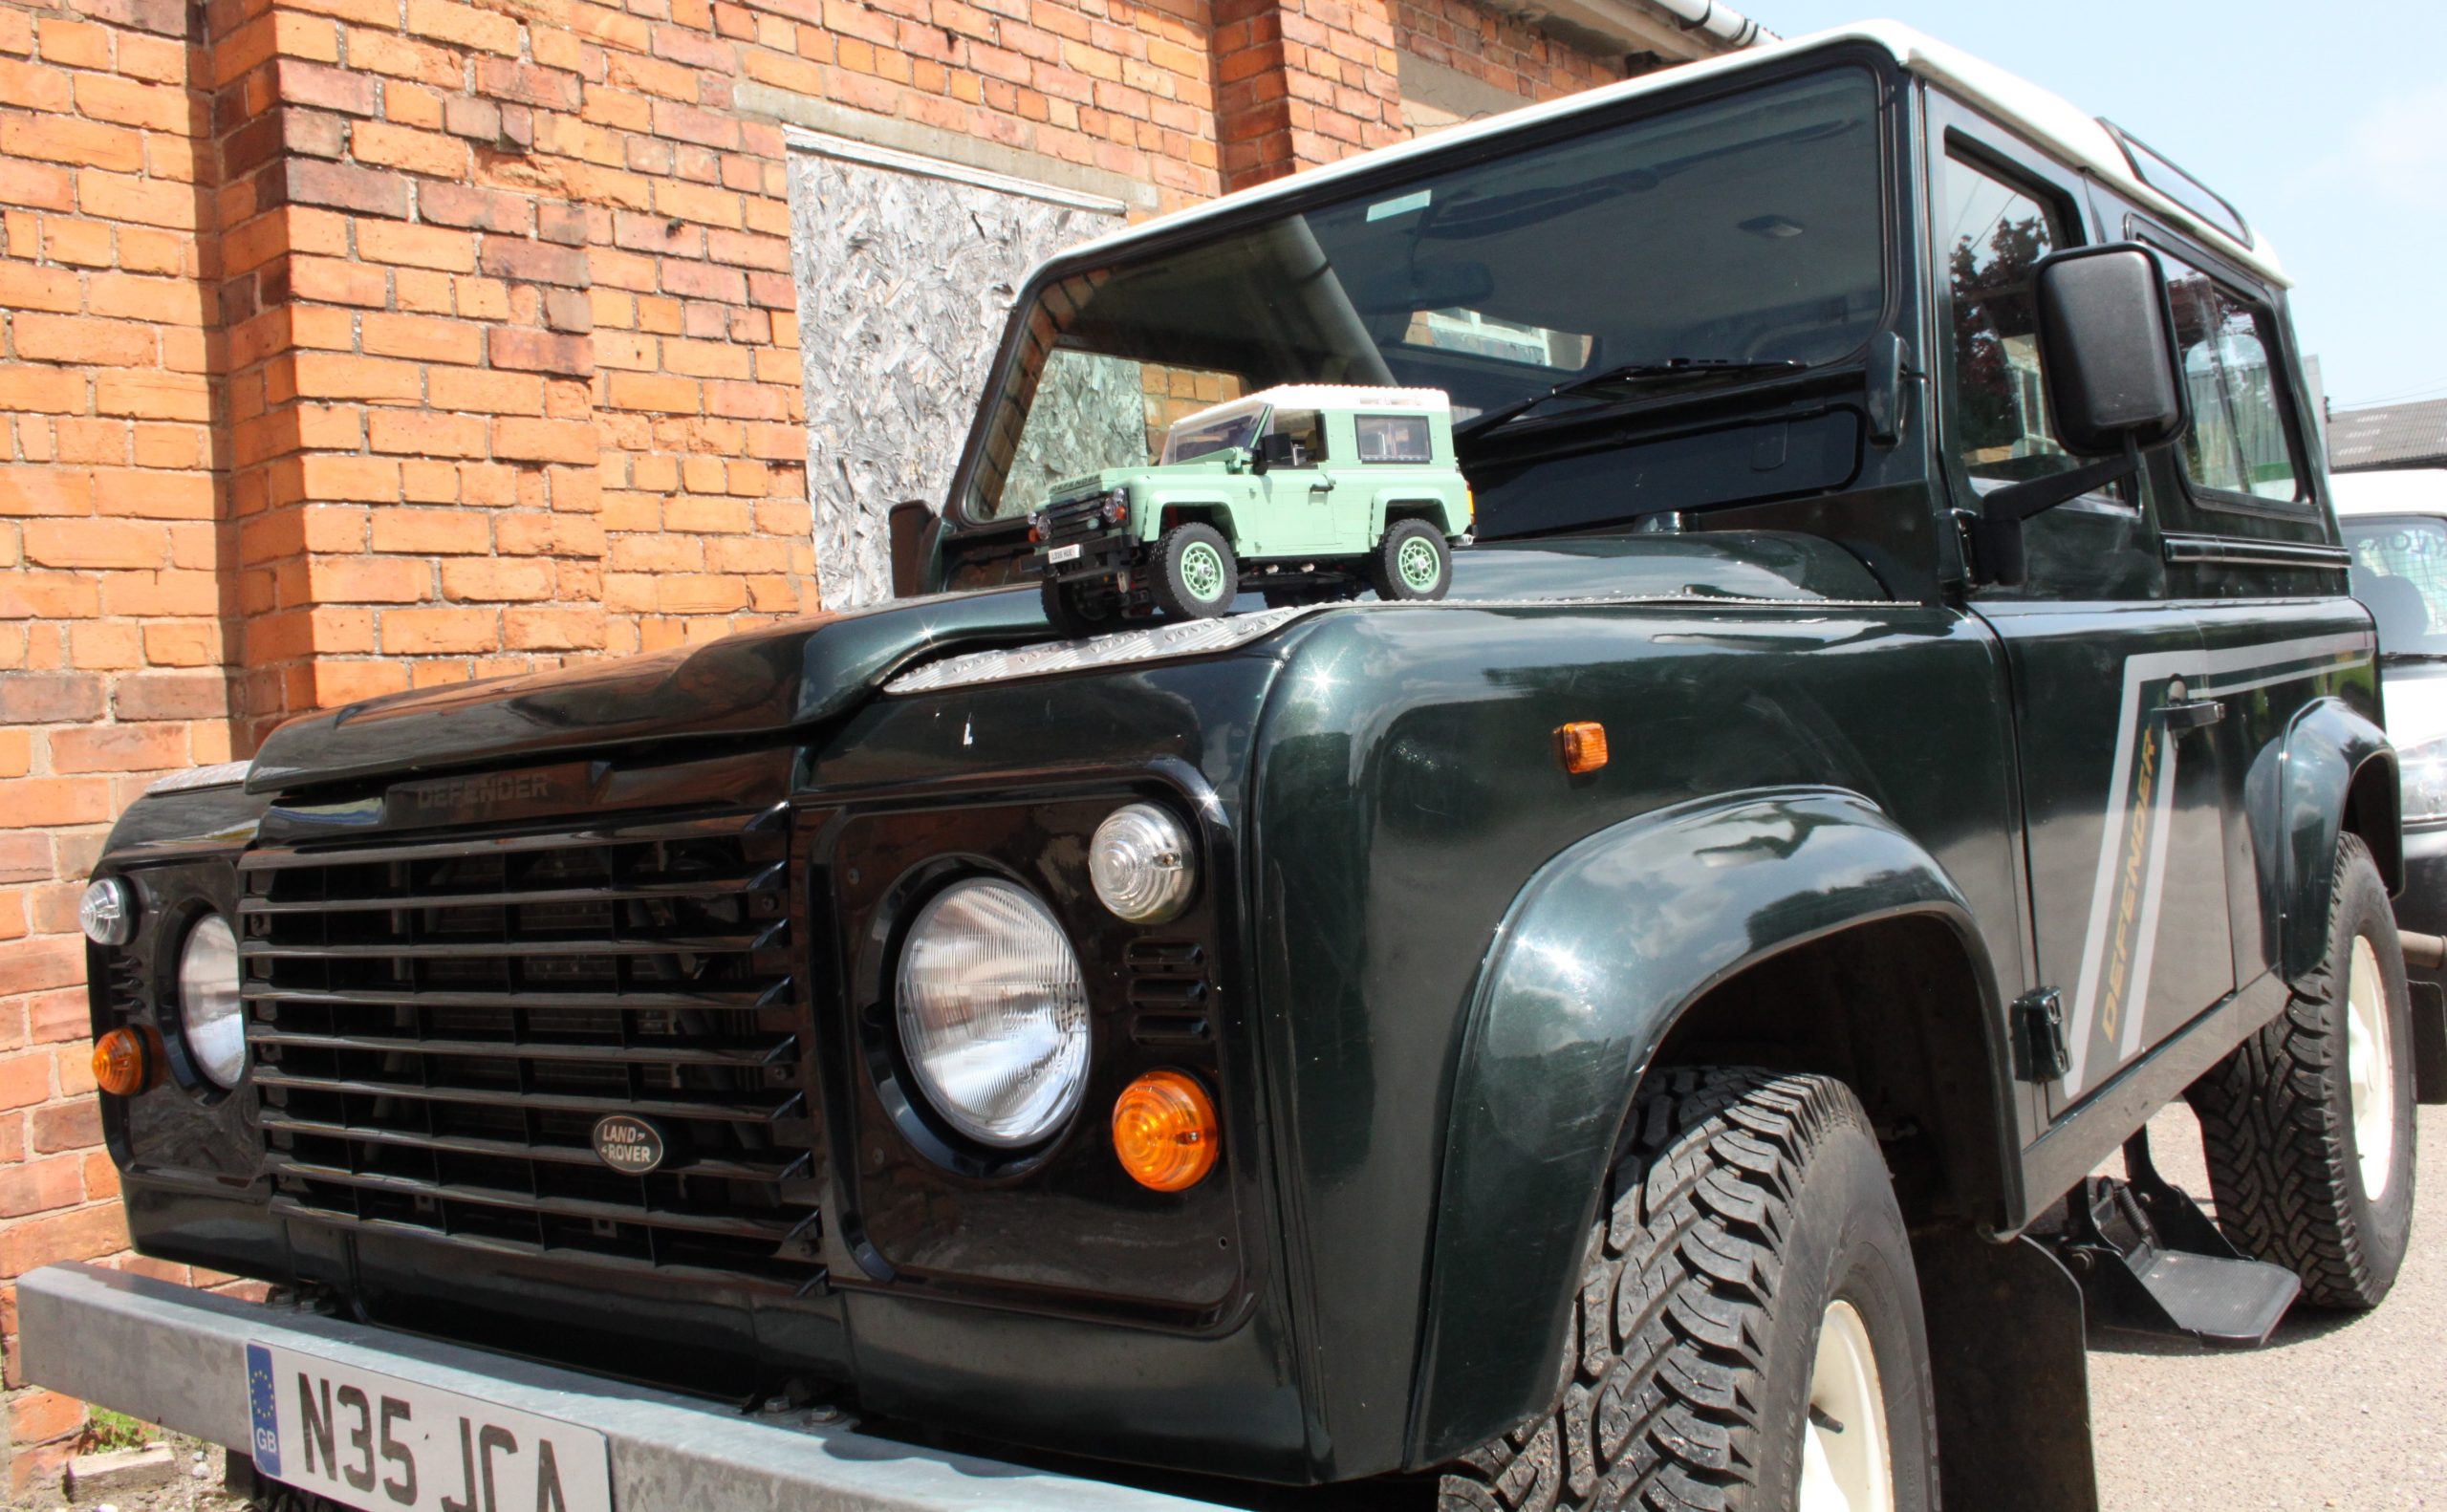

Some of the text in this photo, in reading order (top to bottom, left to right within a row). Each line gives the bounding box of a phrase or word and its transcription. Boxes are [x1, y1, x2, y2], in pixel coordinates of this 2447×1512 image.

[417, 772, 549, 810] DEFENDER
[2103, 725, 2156, 1043] DEFENDER
[602, 1125, 637, 1143] LAND
[608, 1143, 651, 1163] ROVER
[257, 1427, 277, 1453] GB
[298, 1372, 418, 1506] N35
